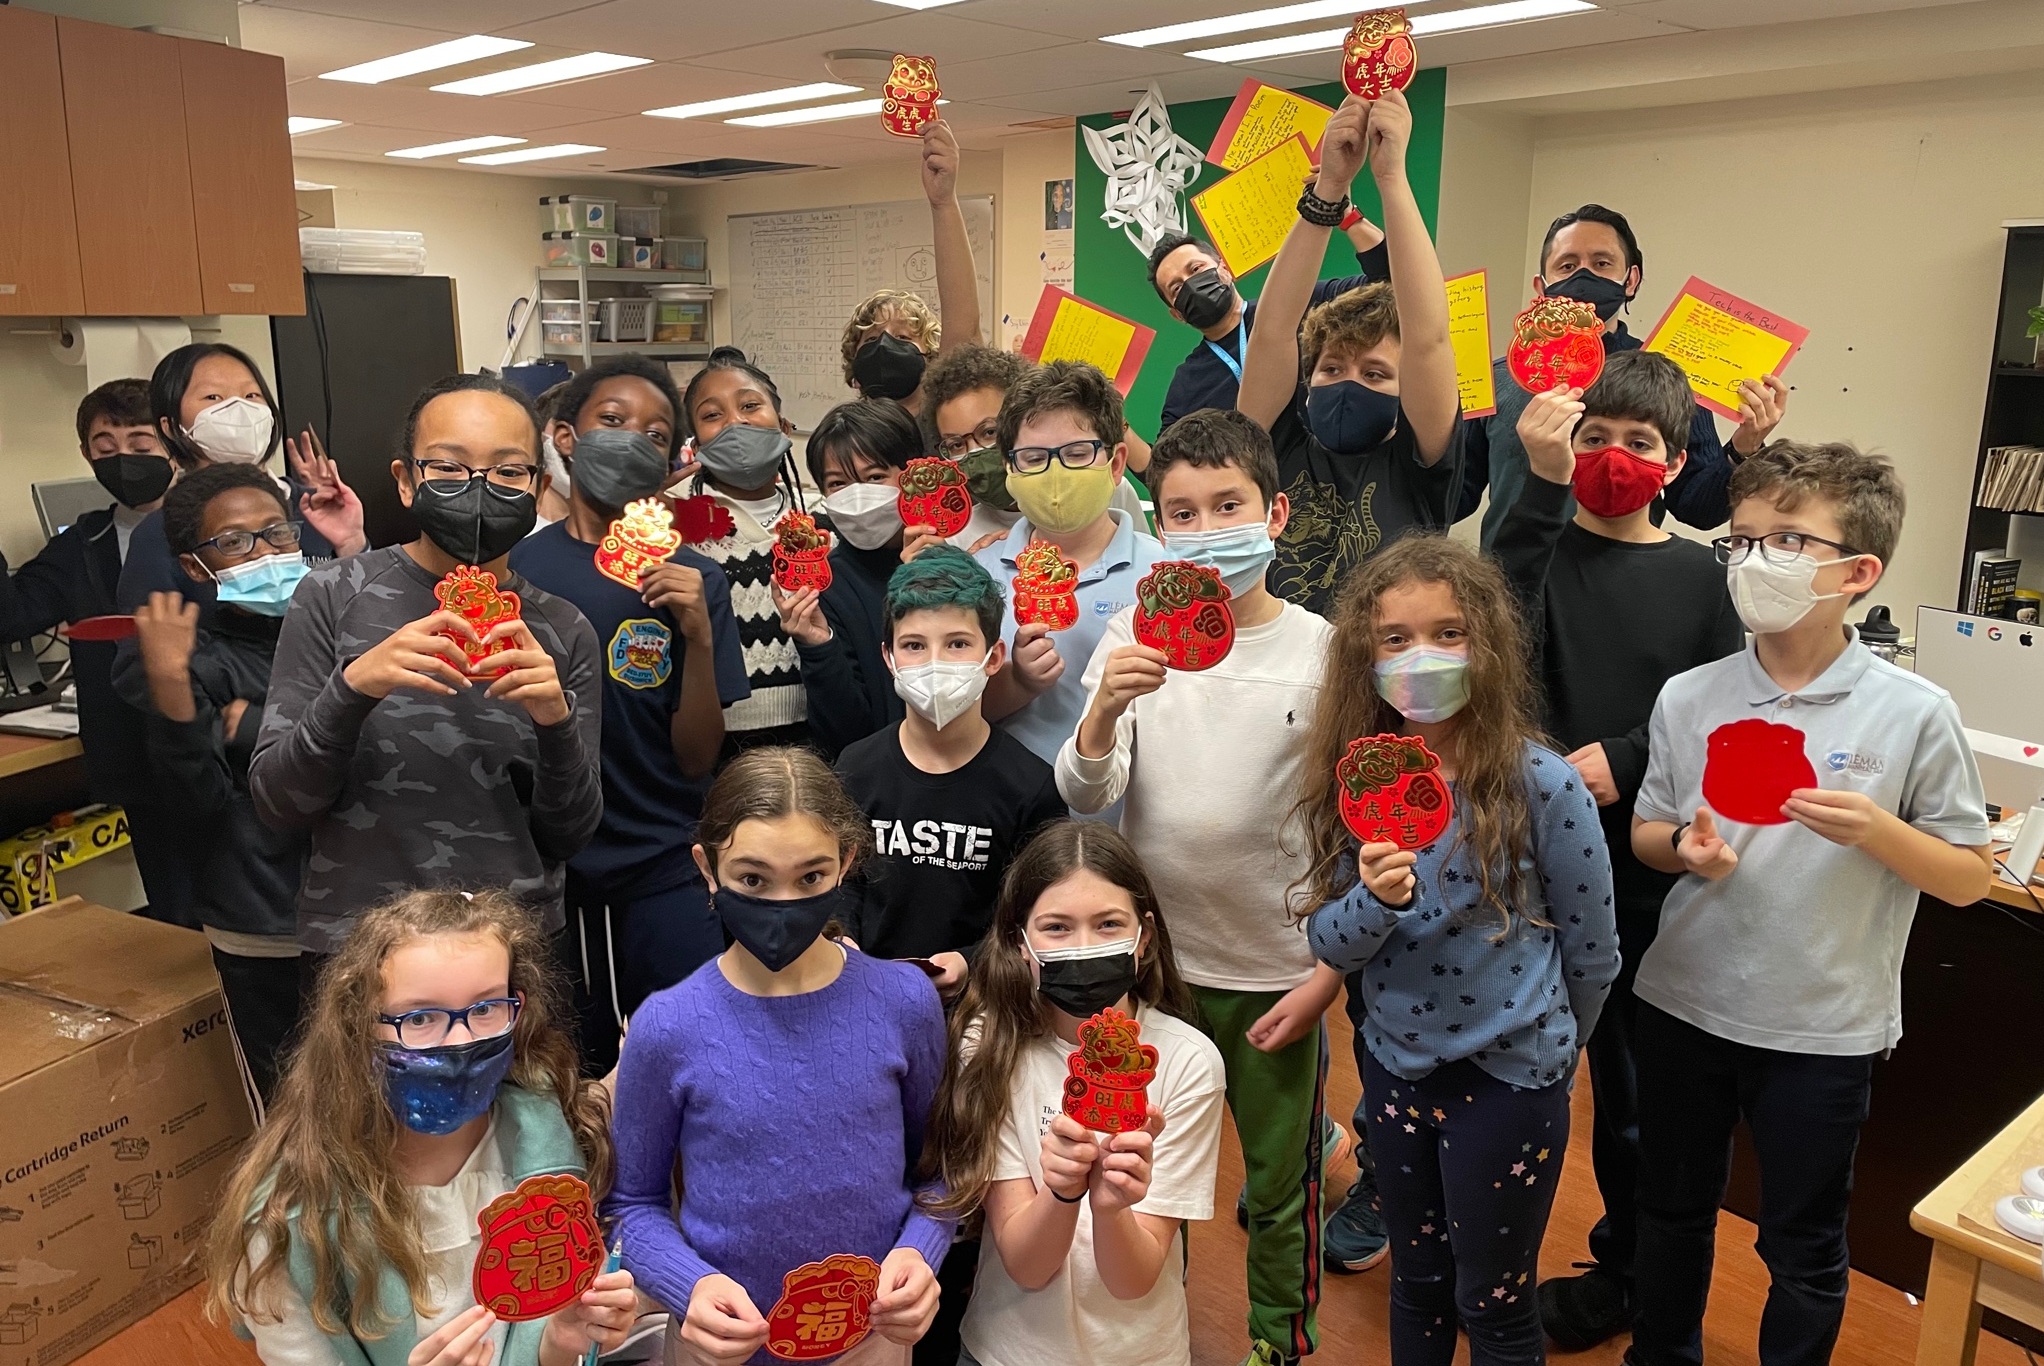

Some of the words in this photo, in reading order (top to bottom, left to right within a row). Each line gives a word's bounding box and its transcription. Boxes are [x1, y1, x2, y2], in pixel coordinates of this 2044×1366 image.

[1355, 62, 1387, 79] 虎年
[1250, 94, 1266, 110] Poem
[1709, 292, 1733, 315] Tech
[1744, 311, 1755, 322] the
[1759, 317, 1779, 331] Best
[1524, 349, 1565, 370] 虎年
[911, 502, 943, 519] 虎年
[636, 625, 666, 638] ENGINE
[1153, 620, 1193, 643] 虎年
[1162, 642, 1201, 666] 大吉
[1363, 801, 1408, 821] 虎年
[871, 819, 993, 862] TASTE
[1372, 820, 1419, 844] 大吉
[912, 855, 926, 864] OF
[927, 856, 946, 867] THE
[946, 861, 988, 871] SEAPORT
[1043, 1105, 1056, 1115] The
[1095, 1091, 1137, 1111] 旺虎
[1084, 1106, 1122, 1129] 添运
[5, 1139, 78, 1184] Cartridge
[80, 1115, 130, 1148] Return
[507, 1233, 572, 1293] 福
[796, 1302, 853, 1342] 福
